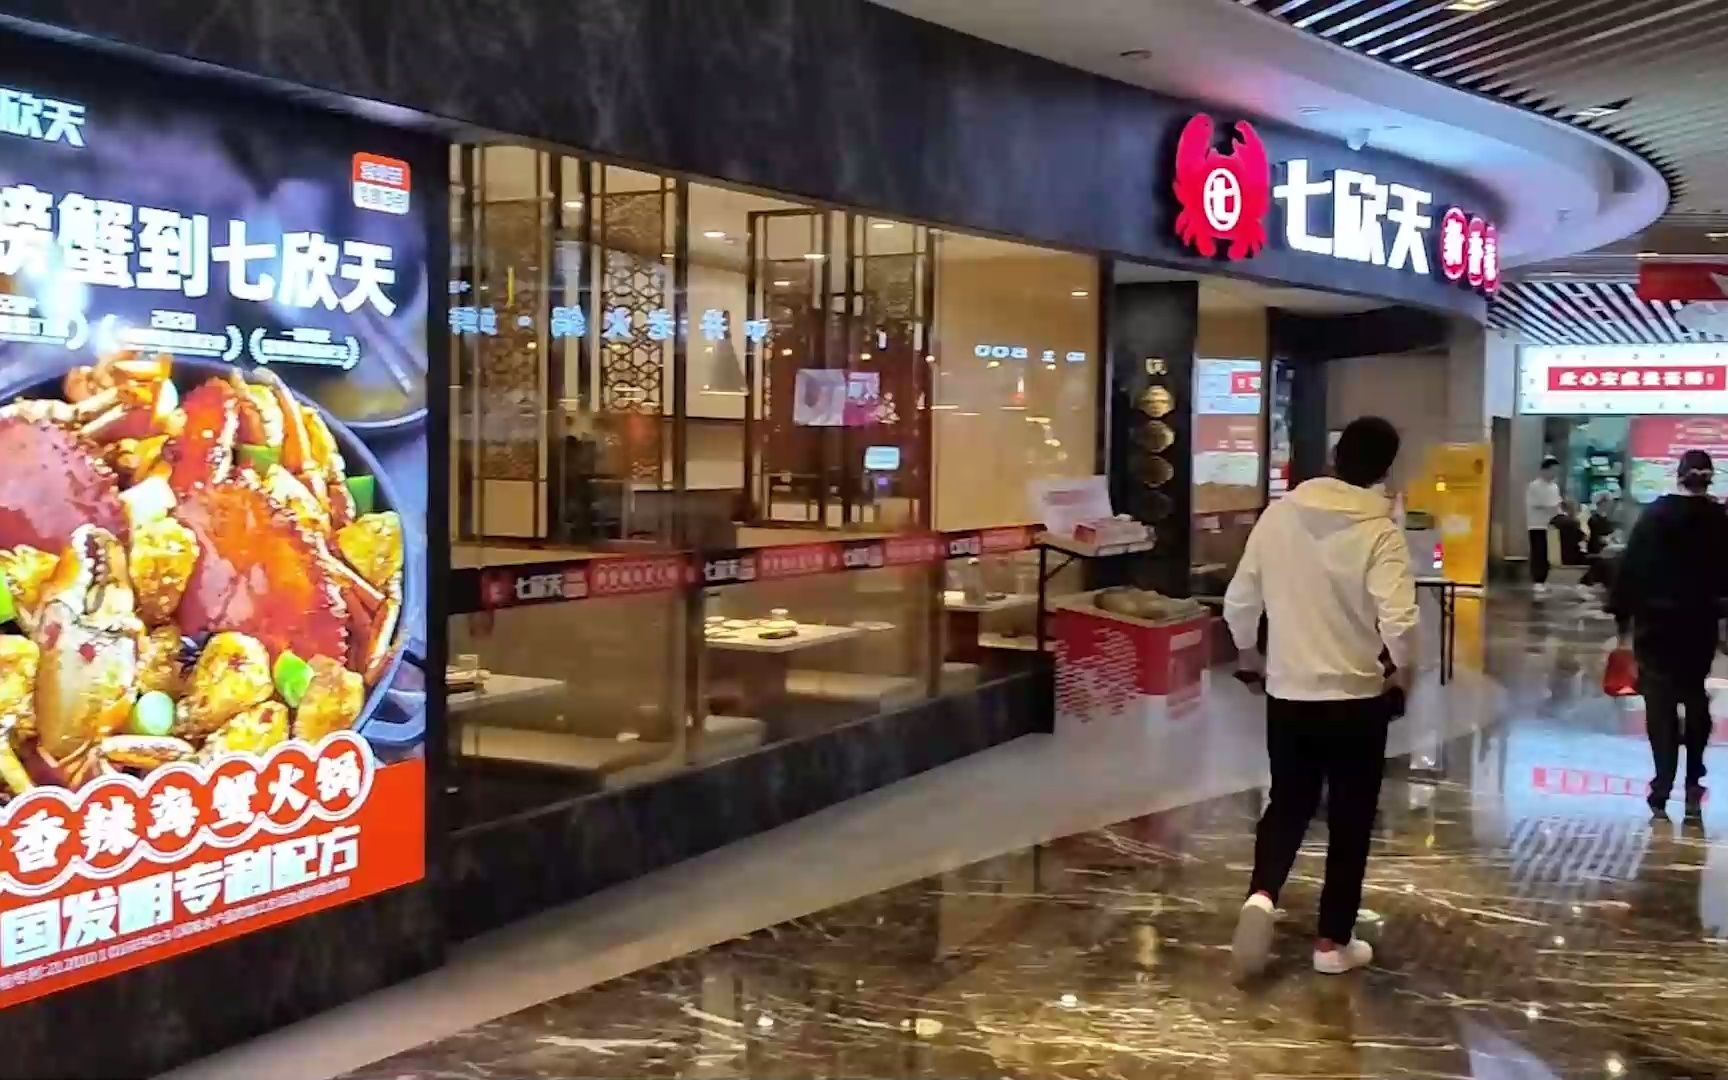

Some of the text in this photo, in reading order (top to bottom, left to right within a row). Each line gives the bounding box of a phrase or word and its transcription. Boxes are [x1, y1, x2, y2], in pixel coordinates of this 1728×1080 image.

[1273, 159, 1432, 274] 七欣天
[11, 750, 361, 873] 香辣海蟹火锅
[0, 825, 361, 969] 国发明专利配方
